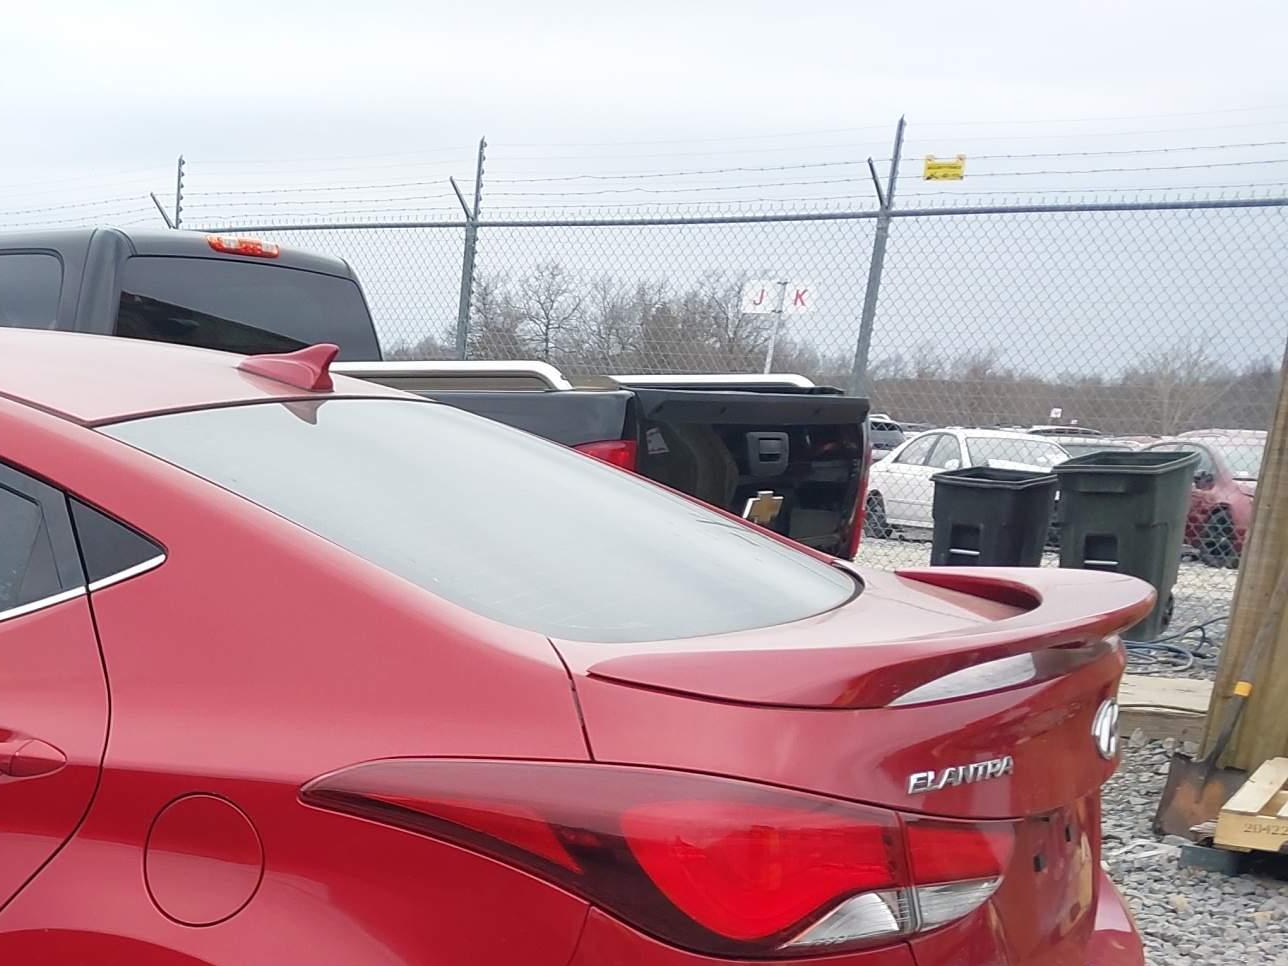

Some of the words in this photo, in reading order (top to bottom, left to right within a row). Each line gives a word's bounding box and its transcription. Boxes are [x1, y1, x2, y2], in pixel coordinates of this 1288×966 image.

[753, 288, 765, 306] J
[792, 288, 809, 307] K
[907, 755, 1014, 795] ELANTRA
